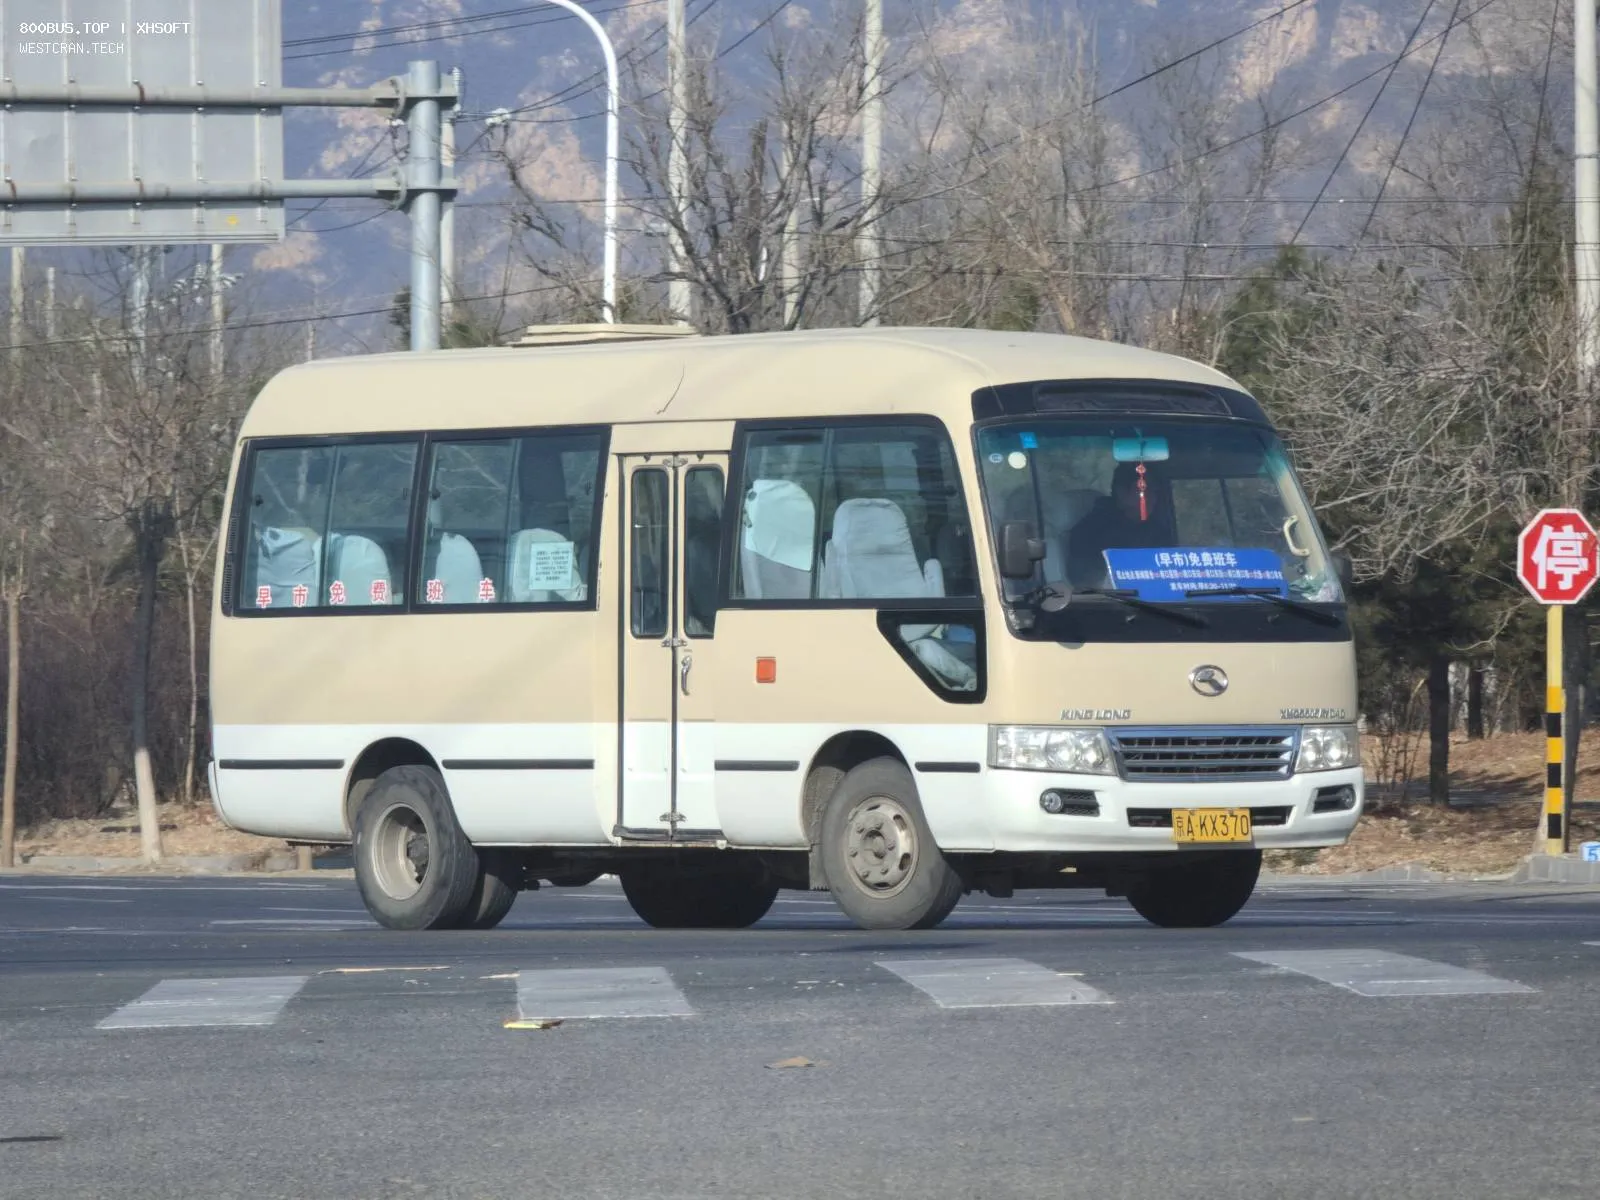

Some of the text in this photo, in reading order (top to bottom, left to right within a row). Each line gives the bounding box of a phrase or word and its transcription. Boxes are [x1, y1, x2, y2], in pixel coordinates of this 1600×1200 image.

[1532, 524, 1588, 591] 停
[1061, 709, 1131, 720] KING LONG
